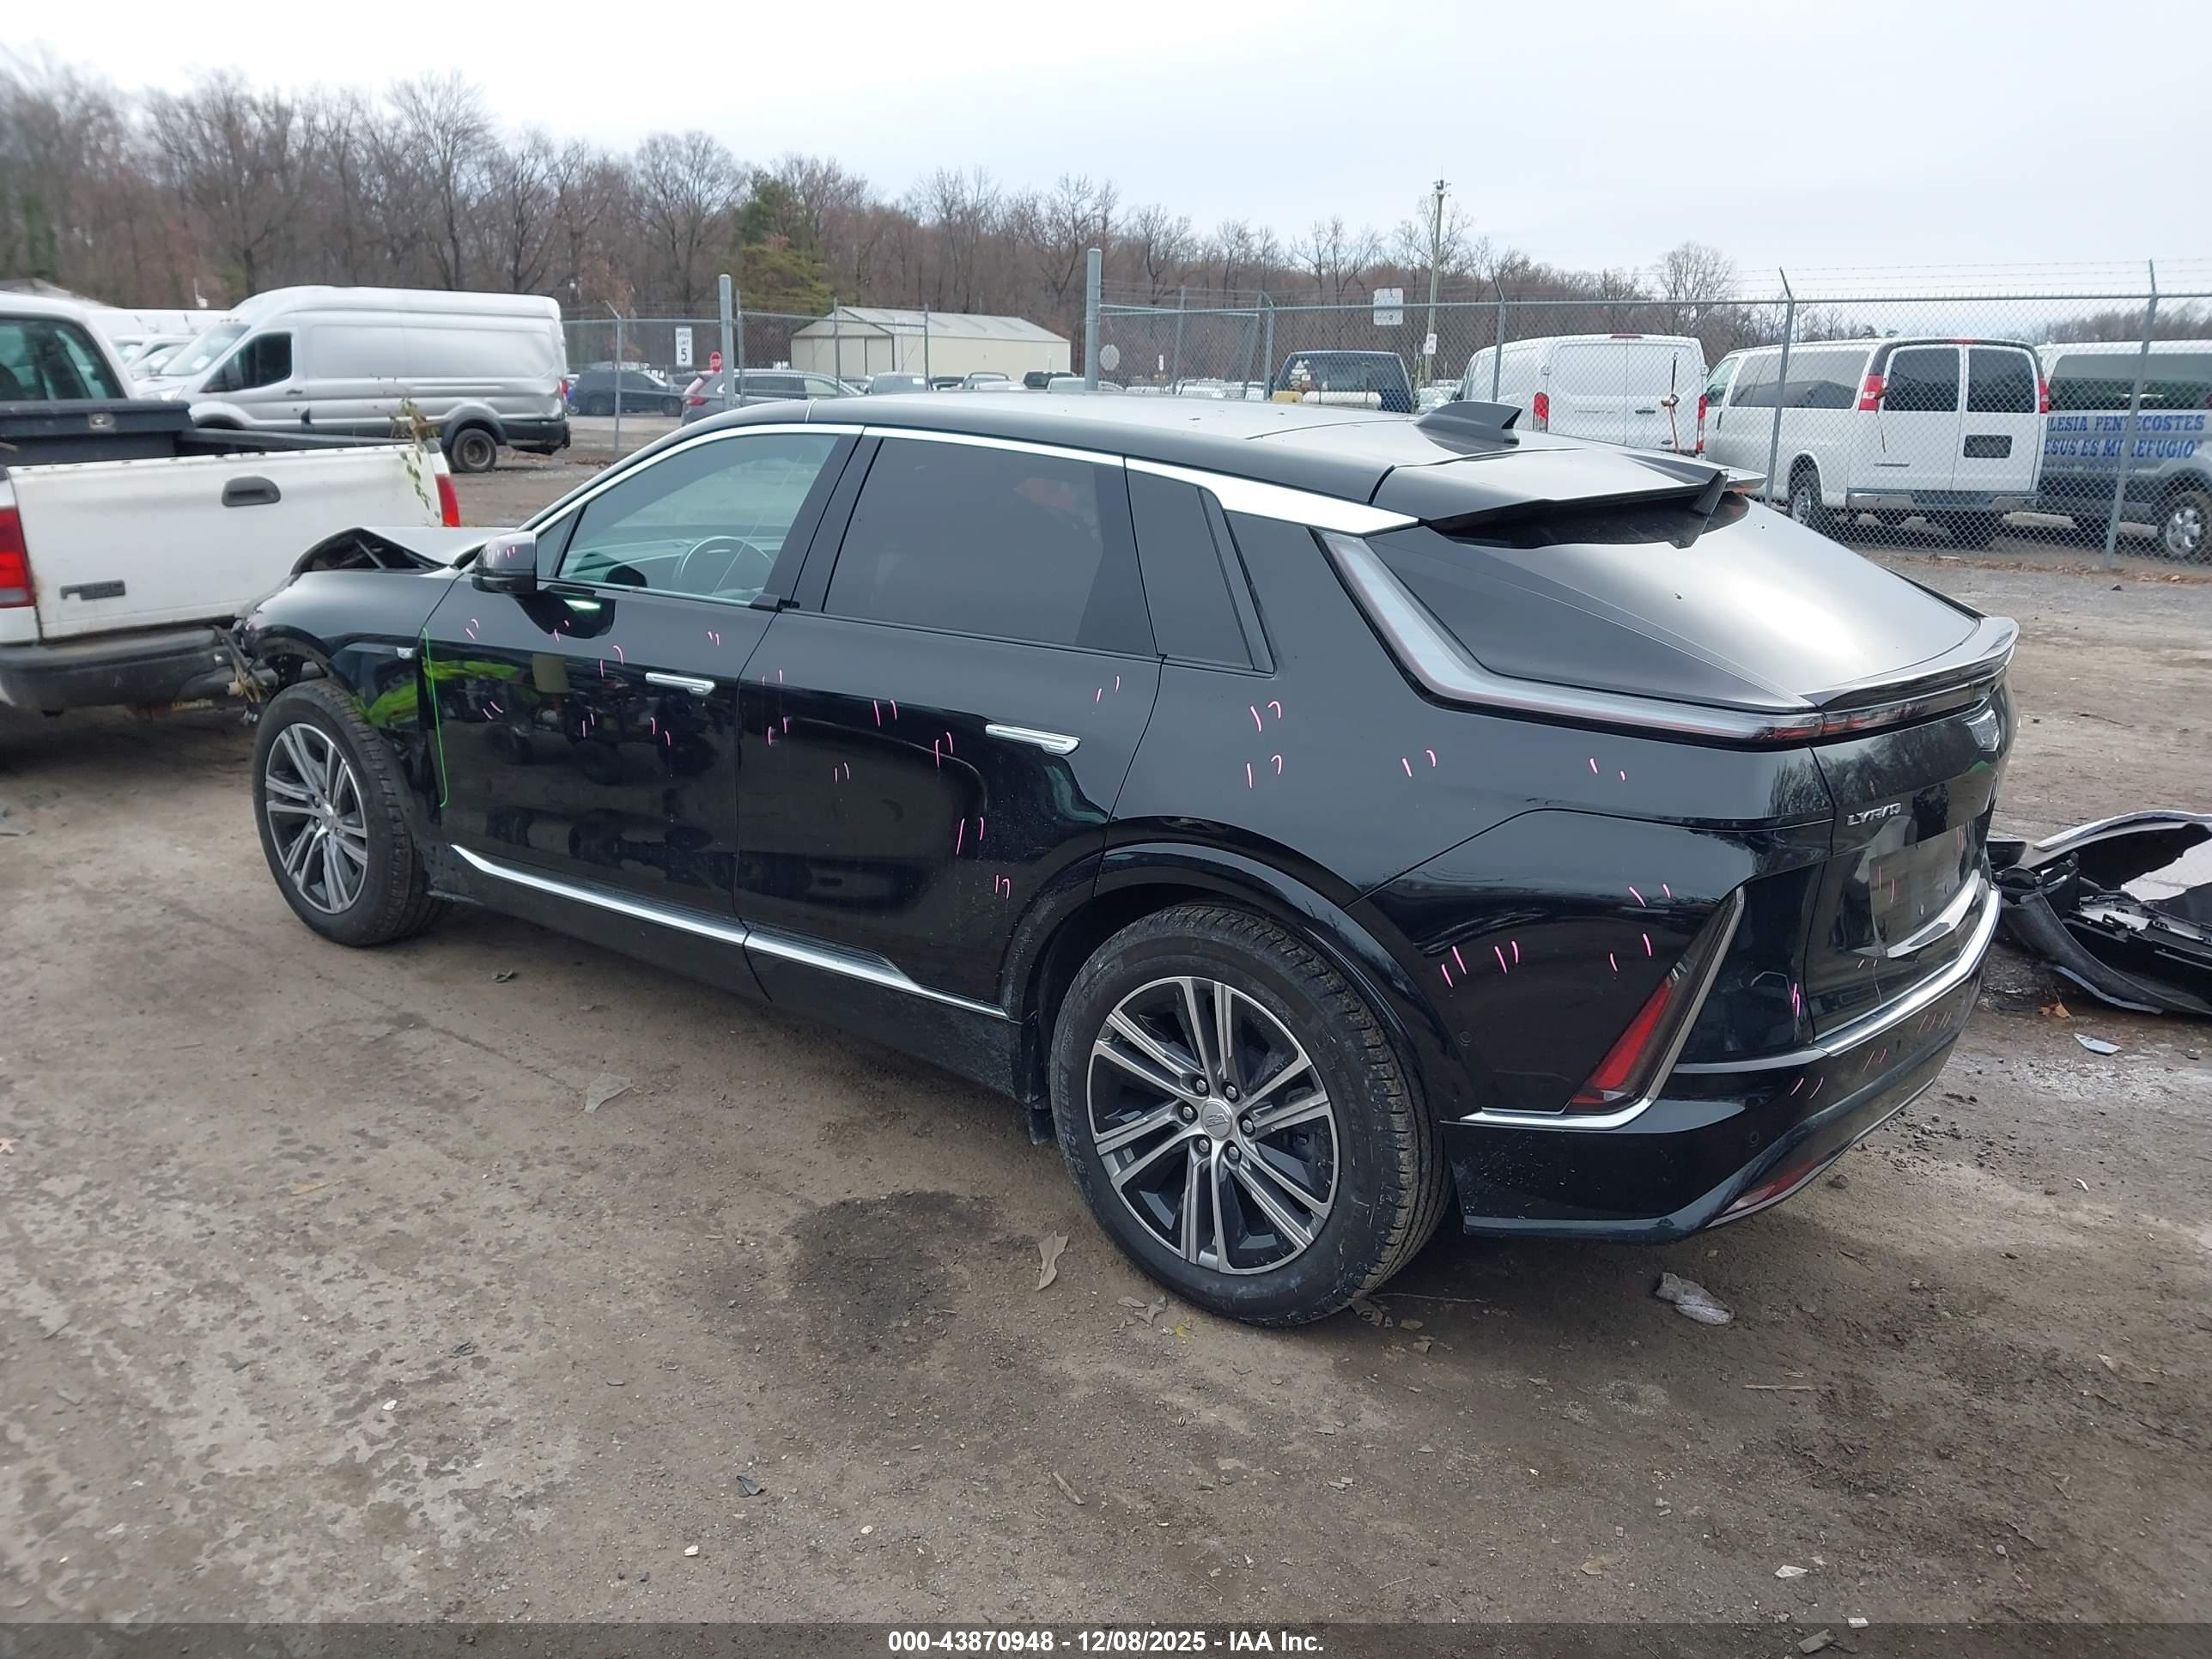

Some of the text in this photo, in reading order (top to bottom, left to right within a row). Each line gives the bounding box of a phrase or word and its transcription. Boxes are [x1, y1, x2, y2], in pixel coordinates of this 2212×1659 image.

[680, 348, 688, 362] 5
[2047, 416, 2088, 431] LESIA
[2081, 439, 2101, 457] ES
[2102, 439, 2124, 457] MI
